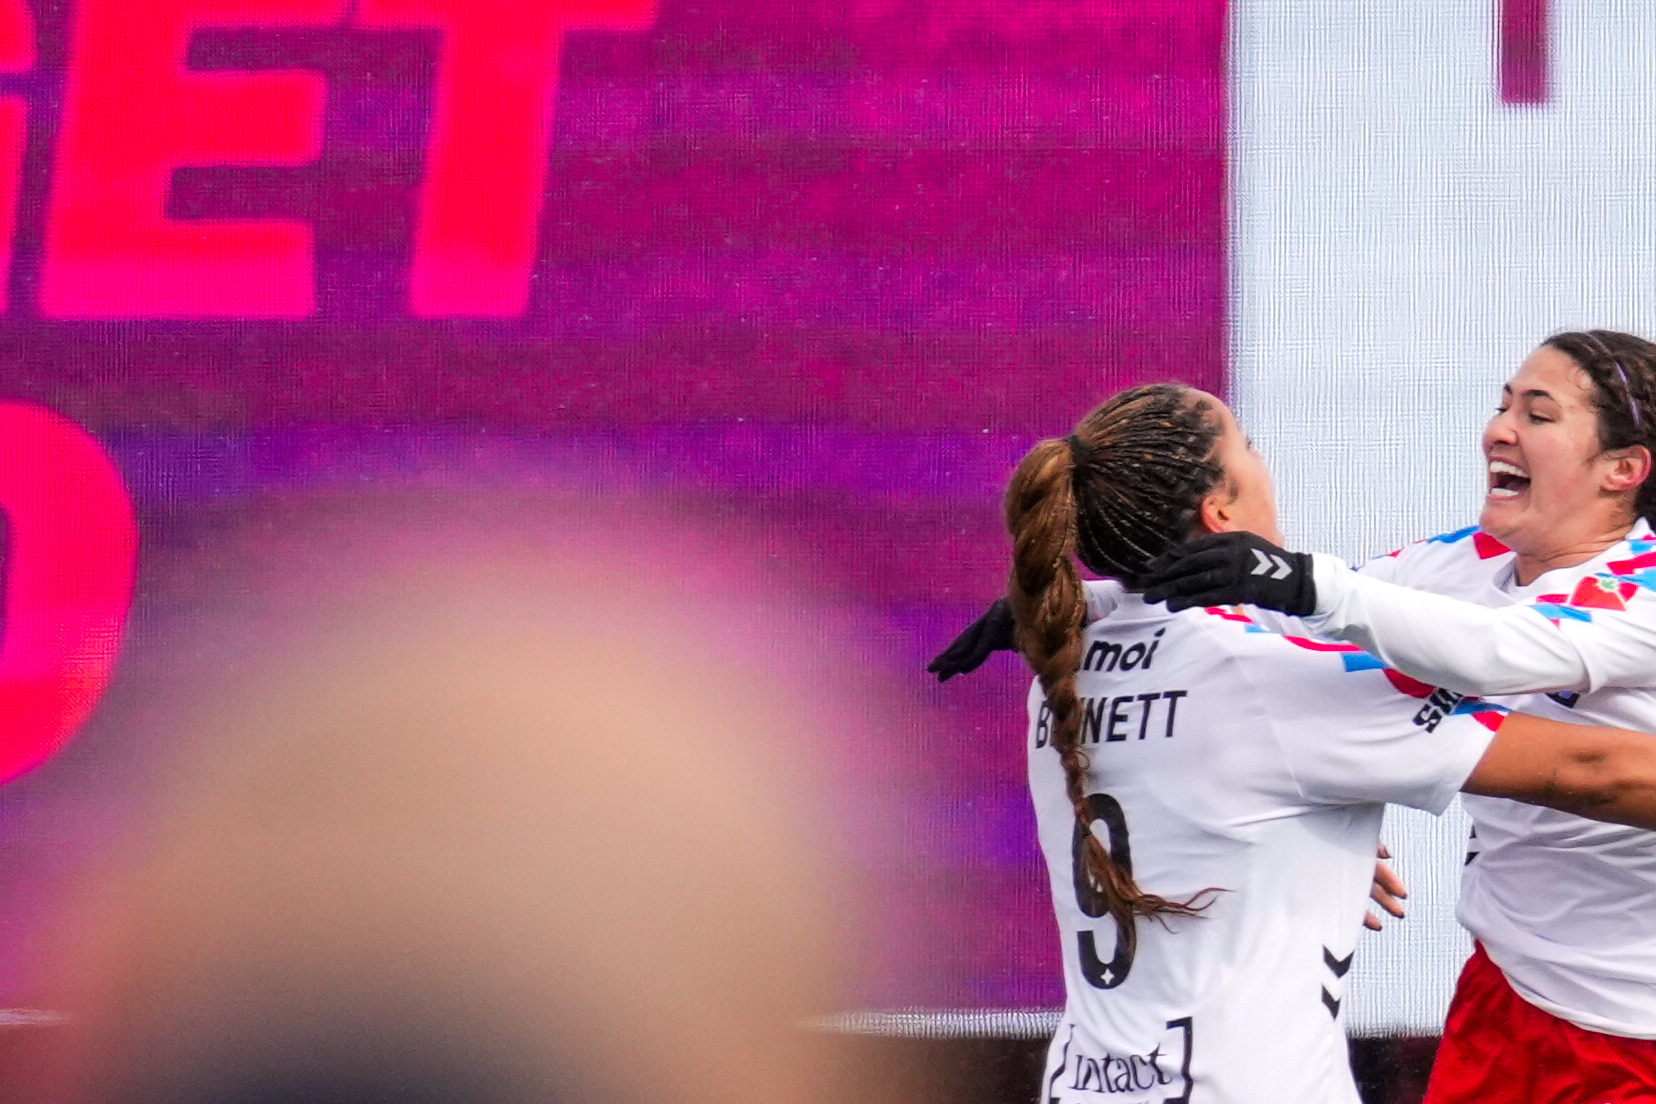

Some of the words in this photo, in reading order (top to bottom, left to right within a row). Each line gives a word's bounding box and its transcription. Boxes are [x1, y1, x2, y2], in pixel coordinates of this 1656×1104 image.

[0, 0, 660, 320] ET
[1083, 627, 1166, 672] moi
[1035, 690, 1188, 749] BNETT
[1071, 792, 1137, 990] 9
